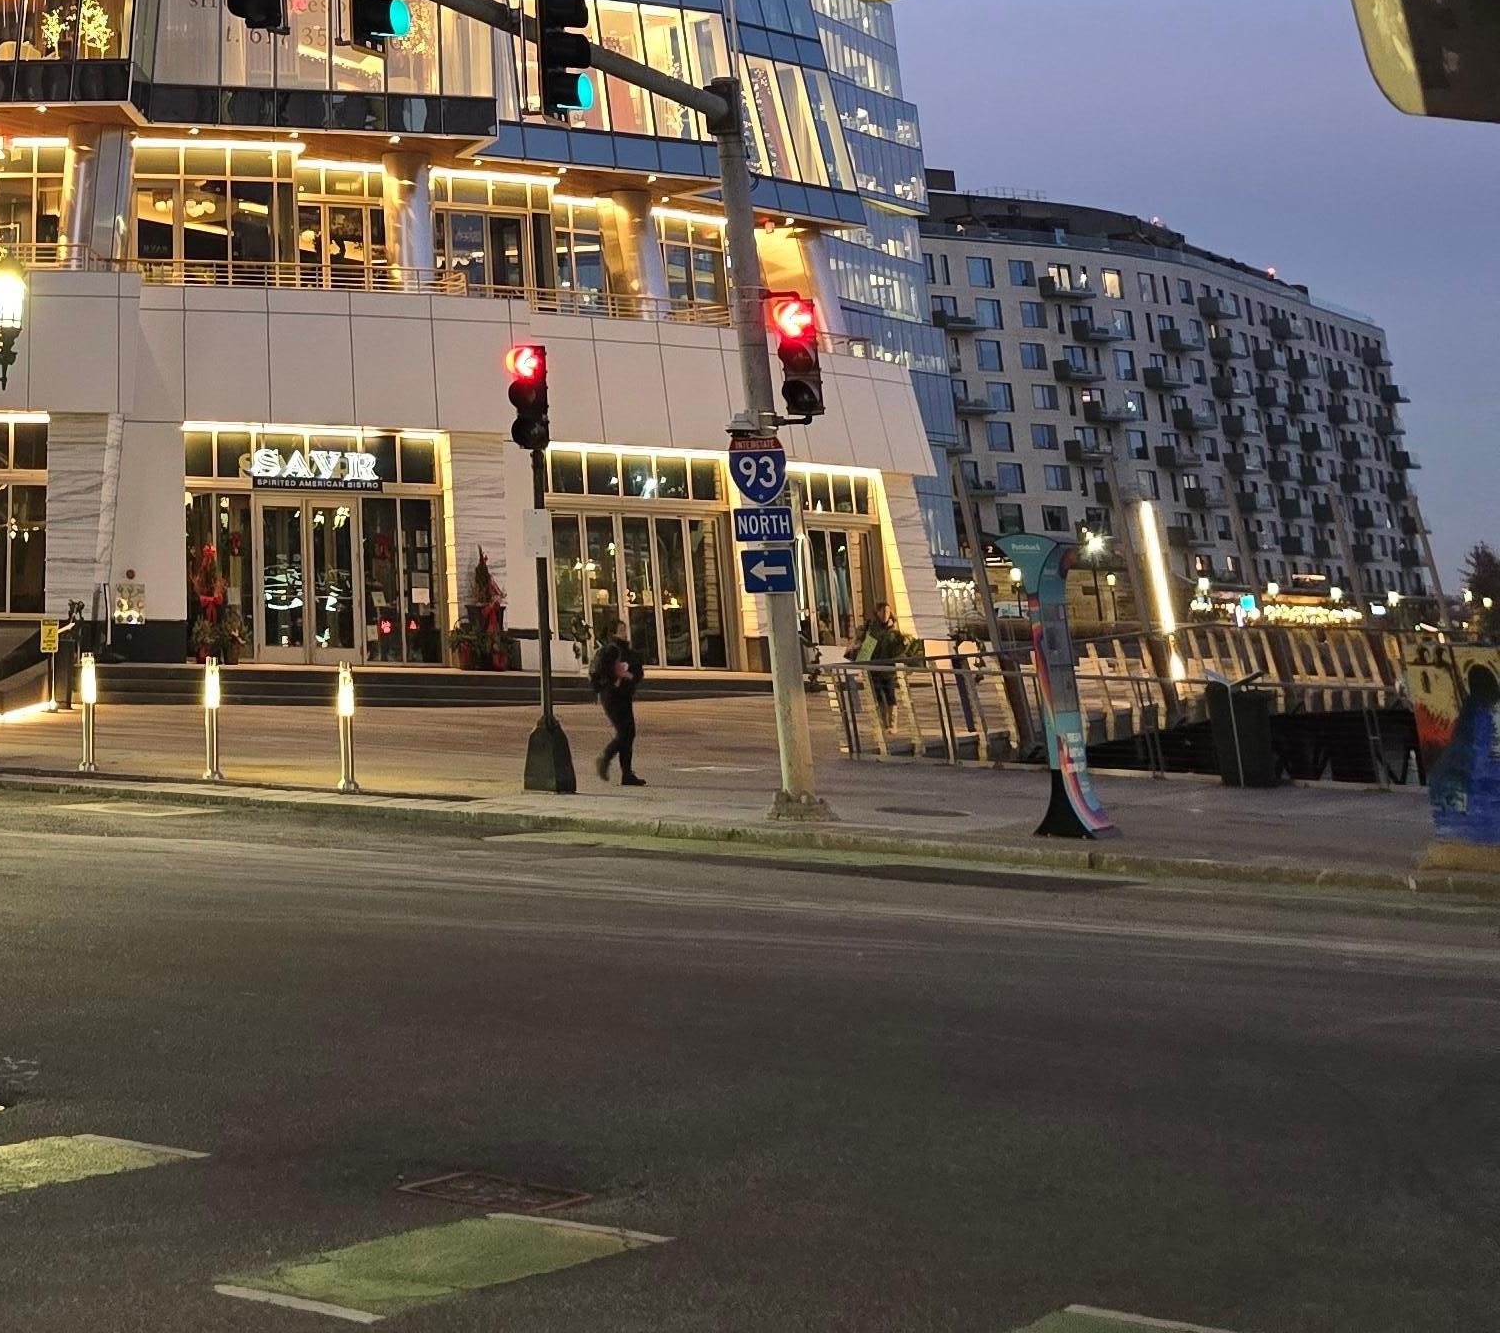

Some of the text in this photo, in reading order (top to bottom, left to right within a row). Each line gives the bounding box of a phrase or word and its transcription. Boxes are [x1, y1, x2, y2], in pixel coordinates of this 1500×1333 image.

[735, 439, 776, 449] INTERSTATE
[250, 448, 380, 482] SAVR
[738, 455, 777, 488] 93
[256, 478, 380, 489] SPIRITED AMERICAN BISTRO
[737, 515, 791, 535] NORTH
